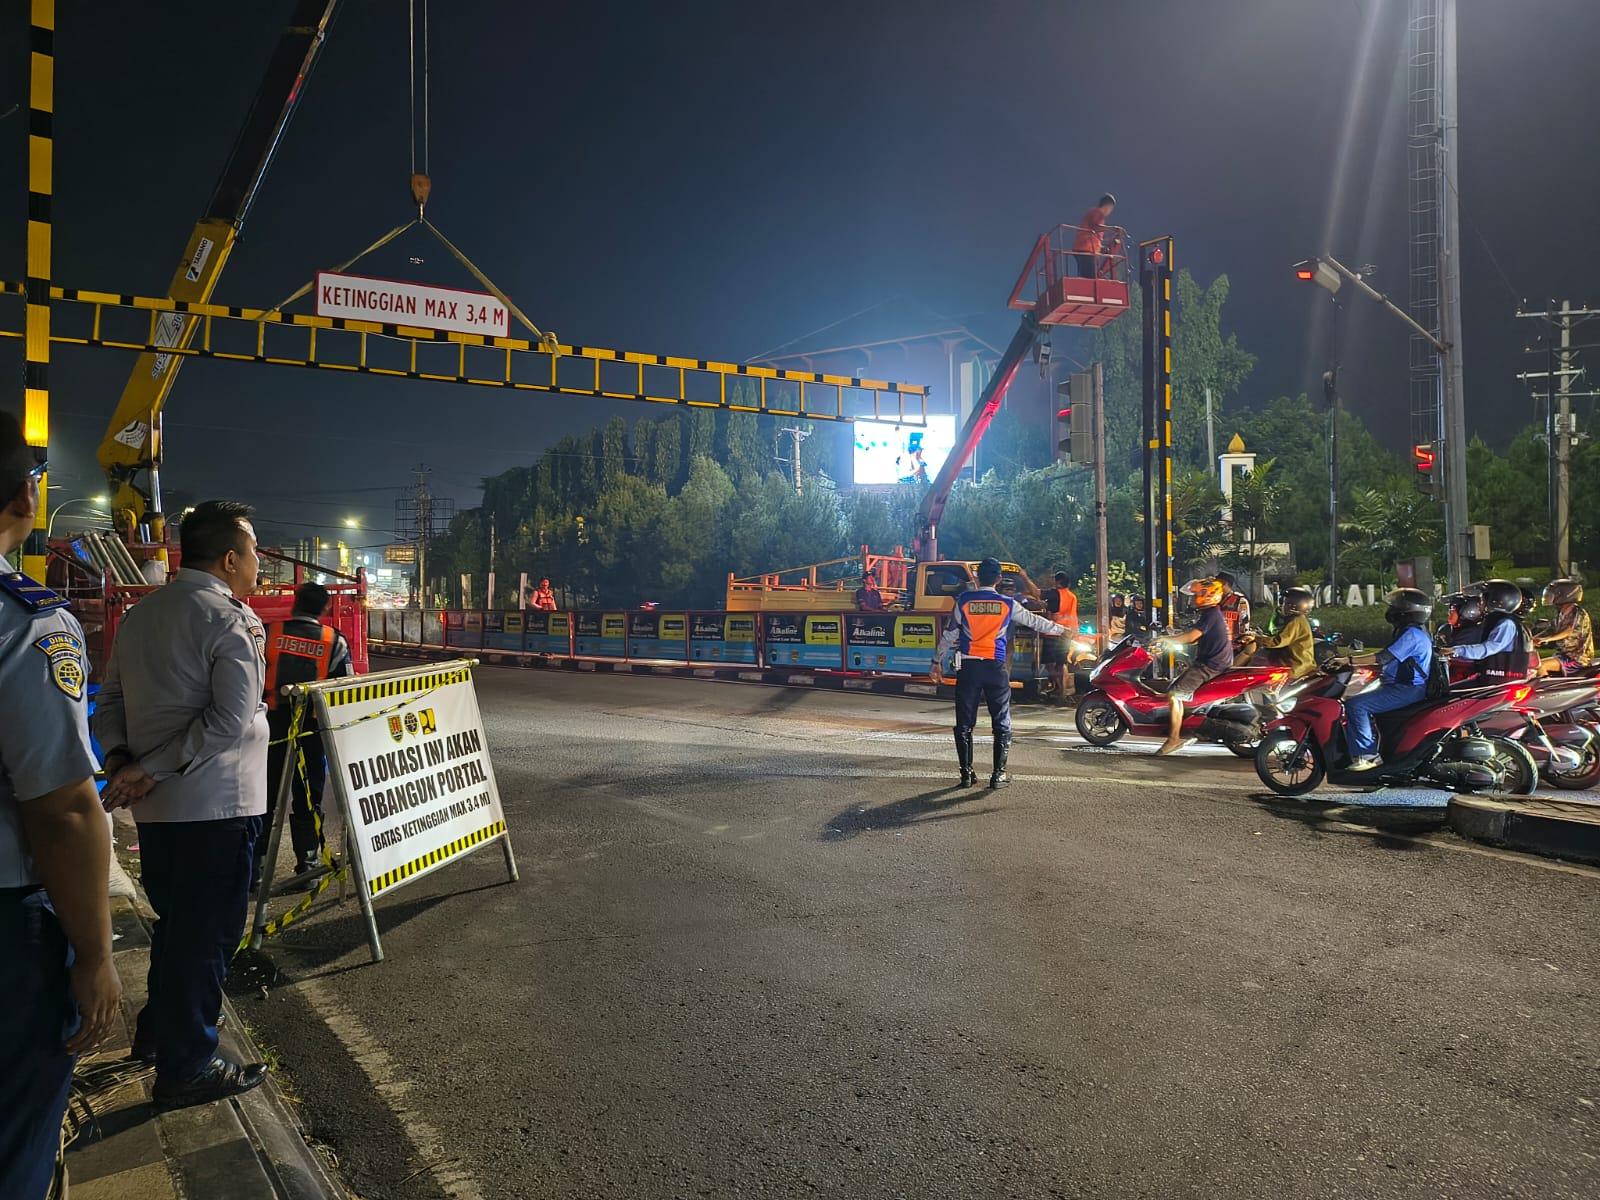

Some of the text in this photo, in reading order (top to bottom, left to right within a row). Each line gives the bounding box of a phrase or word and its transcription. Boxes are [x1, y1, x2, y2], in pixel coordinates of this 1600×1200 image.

[193, 239, 208, 264] TADANO
[322, 285, 504, 326] KETINGGIAN MAX 3,4 M
[969, 602, 1001, 614] DISHUB
[276, 637, 324, 657] DISHUB
[852, 626, 886, 637] Alkaline
[348, 729, 482, 791] DI LOKASI INI AKAN
[358, 759, 488, 826] DIBANGUN PORTAL
[403, 810, 450, 838] KETINGGIAN
[449, 801, 470, 821] MAX
[467, 797, 480, 812] 3.4
